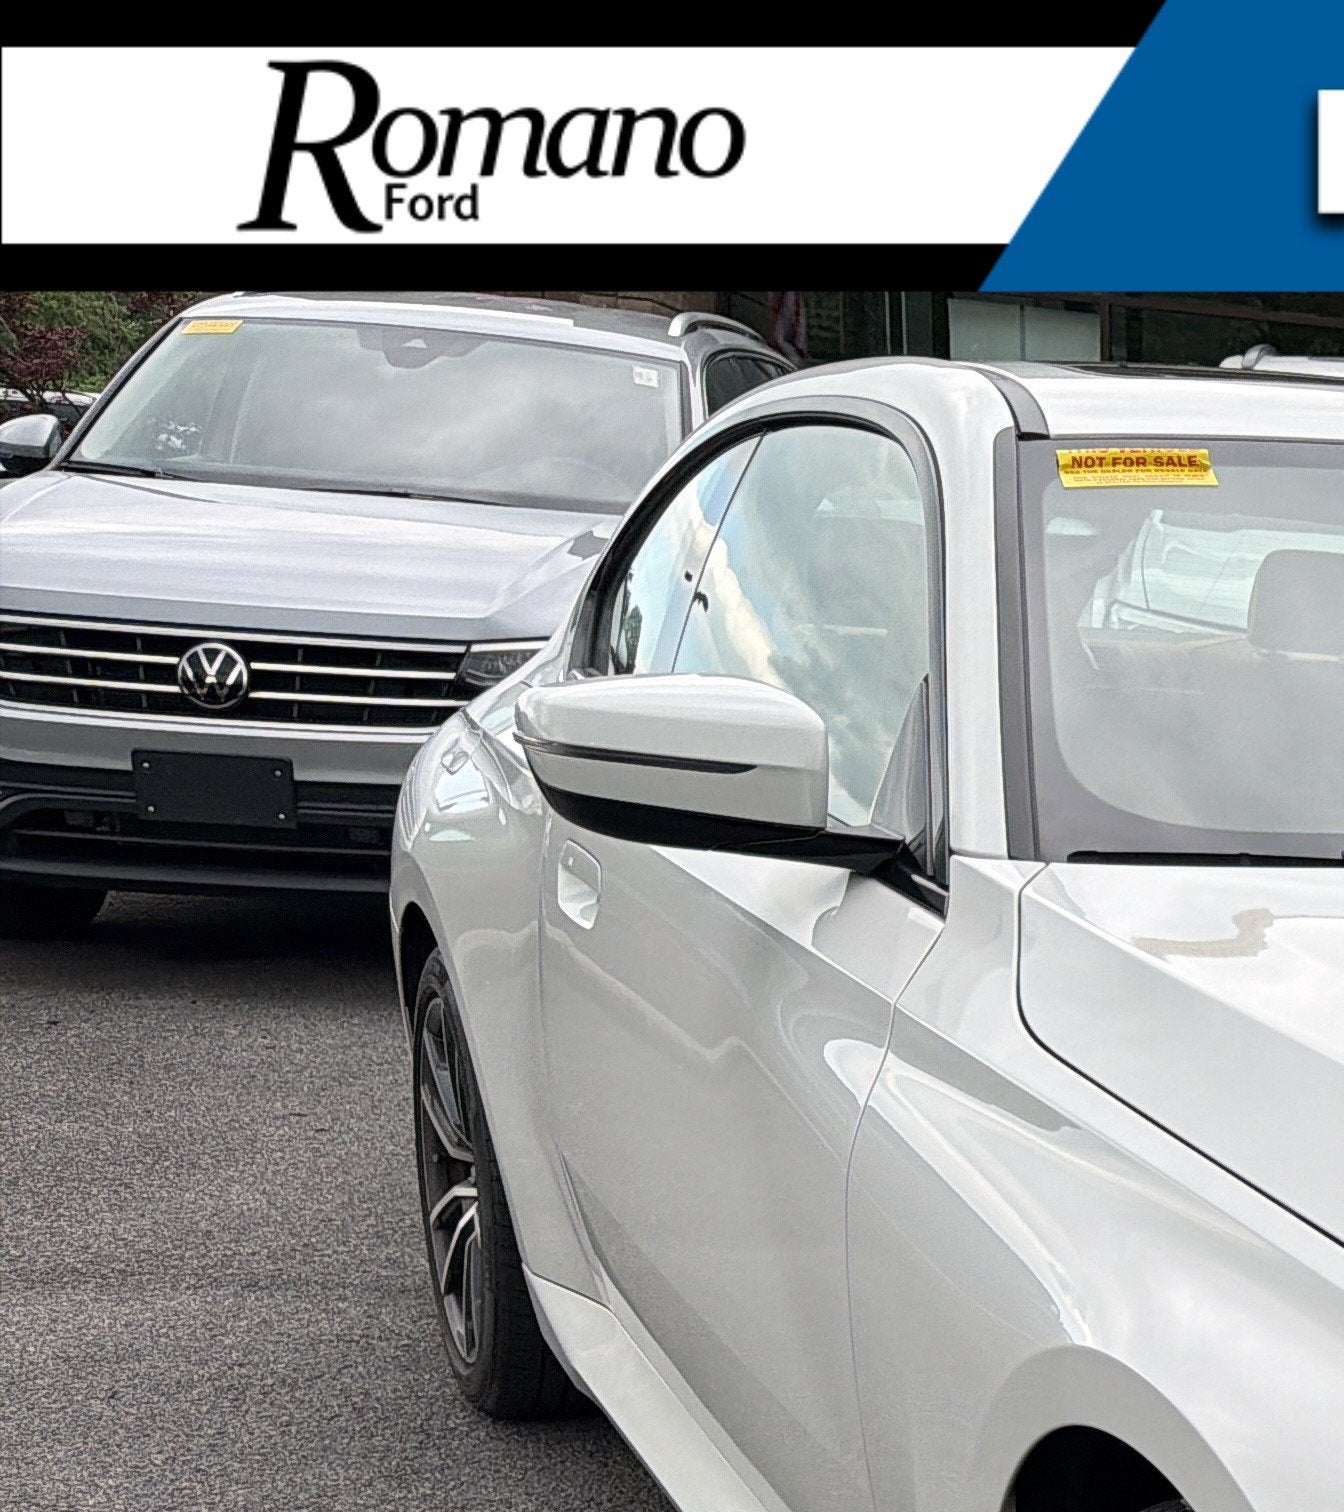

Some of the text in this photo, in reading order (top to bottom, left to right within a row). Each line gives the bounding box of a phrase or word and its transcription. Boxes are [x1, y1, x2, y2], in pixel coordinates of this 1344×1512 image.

[1071, 455, 1198, 469] NOT FOR SALE
